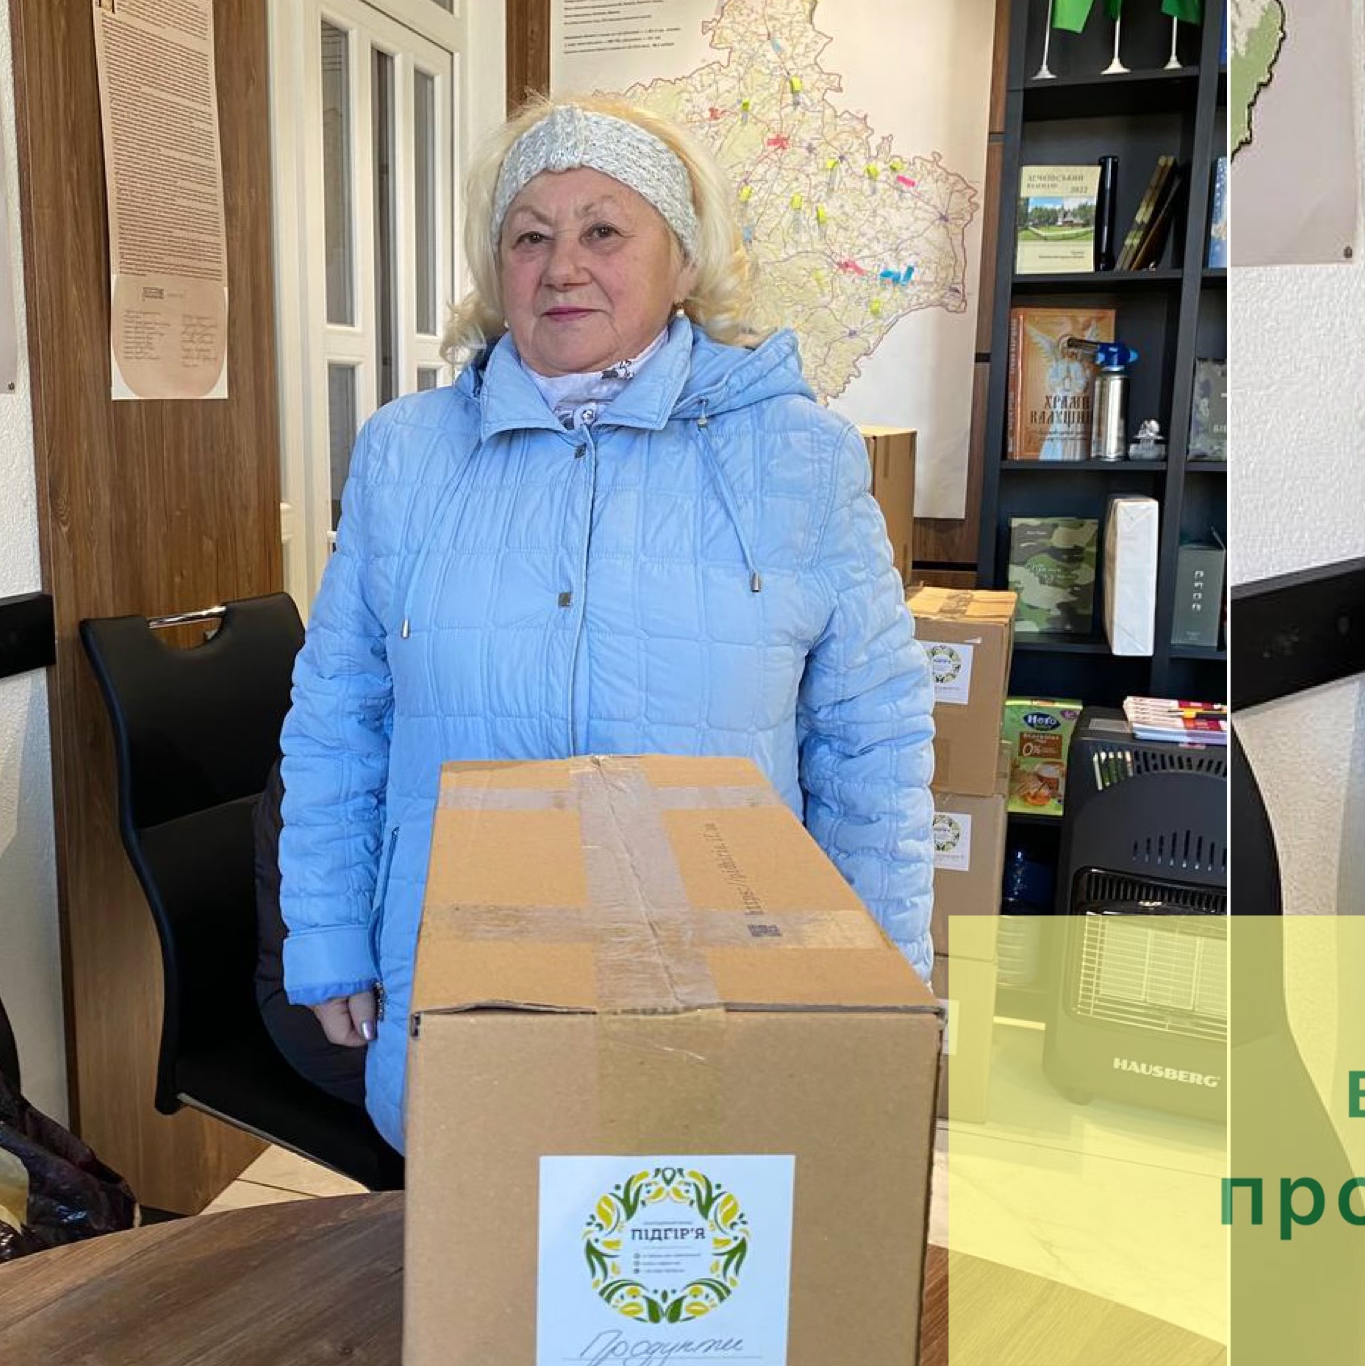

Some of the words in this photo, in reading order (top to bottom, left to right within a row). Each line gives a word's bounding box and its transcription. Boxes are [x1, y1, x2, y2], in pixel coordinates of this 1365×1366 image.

[1026, 713, 1057, 727] Hero
[1113, 1056, 1219, 1088] HAUSBERG
[631, 1226, 706, 1241] ПІДГІР'Я
